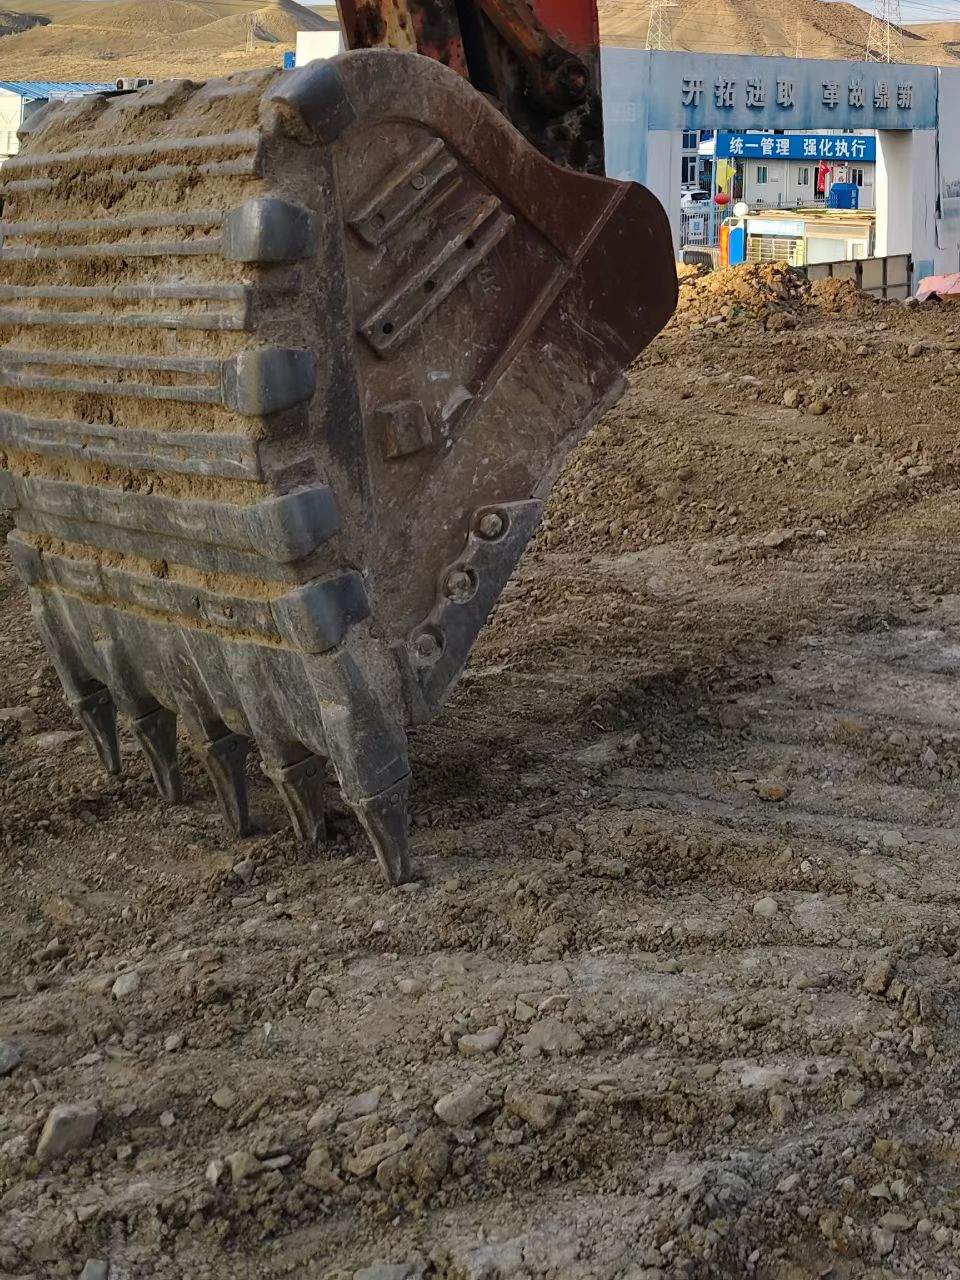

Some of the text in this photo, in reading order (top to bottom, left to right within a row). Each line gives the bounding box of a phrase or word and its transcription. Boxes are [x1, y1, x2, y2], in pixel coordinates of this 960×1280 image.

[682, 77, 914, 110] 开拓进取 革故鼎新
[729, 136, 867, 158] 统一管理 强化执行
